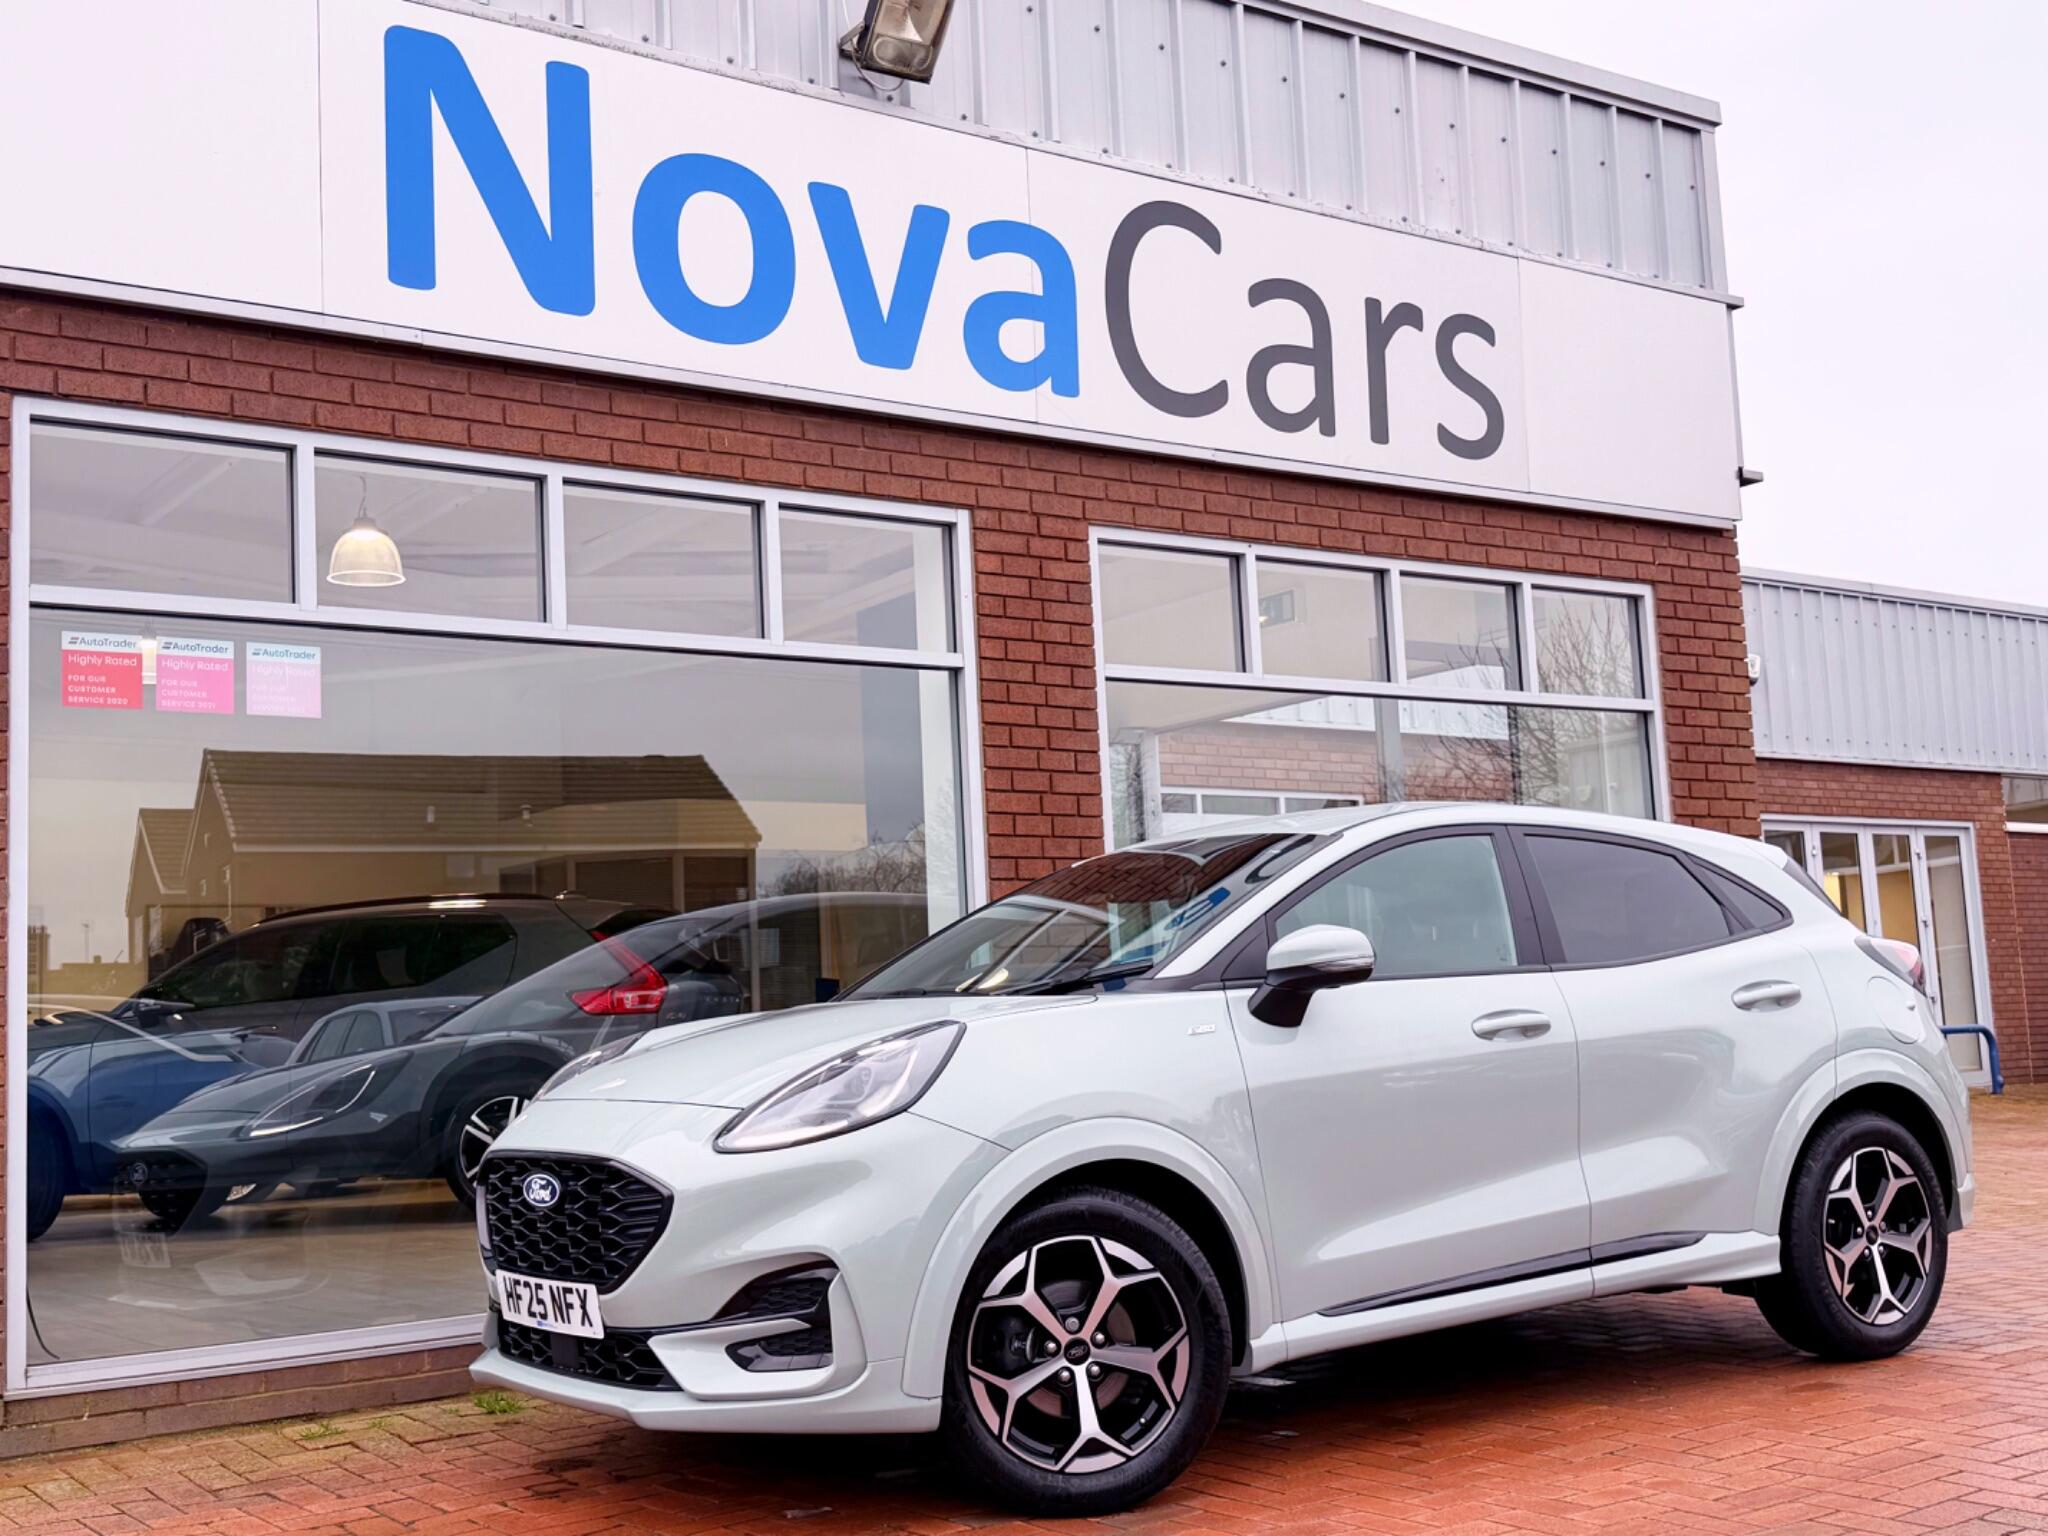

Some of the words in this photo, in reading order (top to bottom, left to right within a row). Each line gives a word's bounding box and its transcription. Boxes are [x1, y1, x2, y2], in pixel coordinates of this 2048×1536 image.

[384, 25, 1505, 460] NovaCars
[79, 636, 137, 648] AutoTrader
[173, 642, 229, 653] AutoTrader
[68, 654, 103, 666] Highly
[105, 655, 137, 666] Rated
[262, 648, 316, 660] AutoTrader
[162, 658, 196, 670] Highly
[197, 660, 229, 671] Rated
[68, 674, 86, 682] FOR
[87, 675, 106, 683] OUR
[68, 685, 116, 693] CUSTOMER
[68, 695, 104, 704] SERVICE
[503, 1275, 548, 1320] HF25
[549, 1284, 594, 1327] NFX
